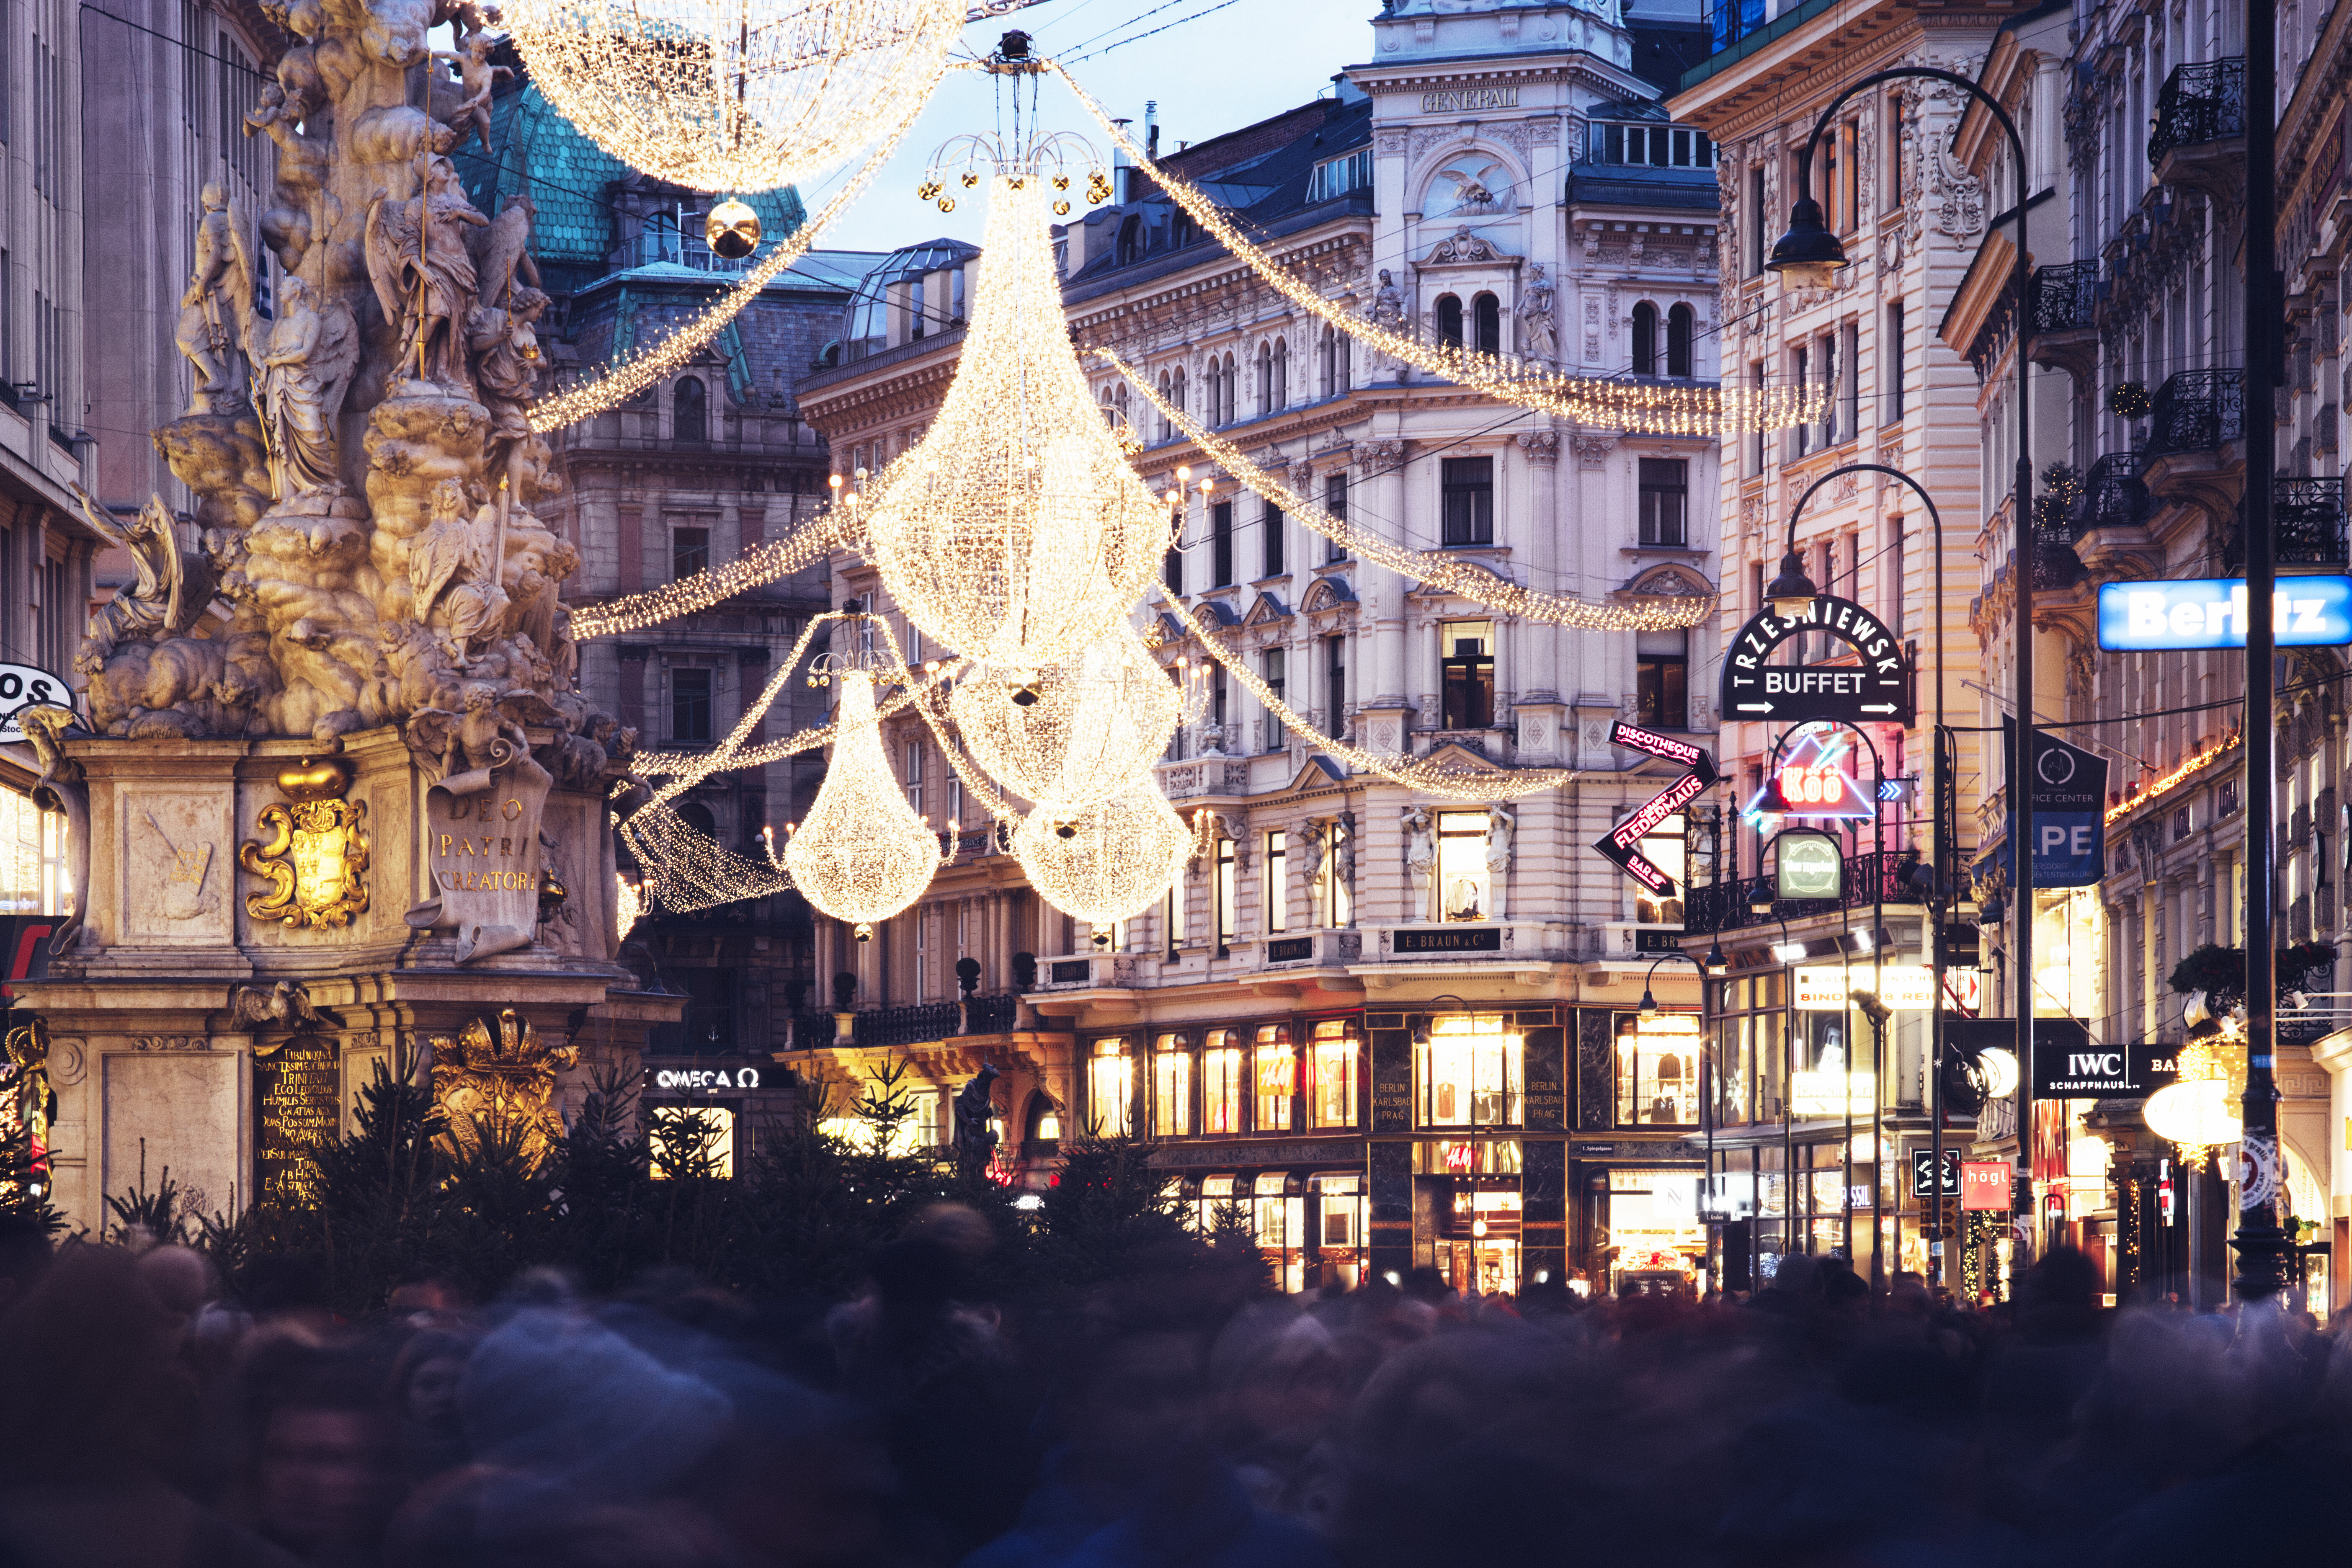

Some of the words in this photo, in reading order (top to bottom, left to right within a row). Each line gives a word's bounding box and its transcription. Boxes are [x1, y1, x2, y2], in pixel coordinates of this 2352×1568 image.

[1420, 85, 1519, 113] GENERALI
[2129, 586, 2326, 636] Berltz
[1766, 673, 1866, 694] BUFFET
[1617, 725, 1700, 759] DISCOTHEQUE
[451, 796, 522, 821] DEO
[1614, 778, 1702, 849] FLEDERMAUS
[1639, 792, 1668, 818] CABARET
[441, 835, 529, 856] PATRI
[1629, 855, 1651, 876] BAR
[438, 870, 536, 891] CREATORI
[1280, 944, 1297, 956] BRAUN
[1406, 936, 1415, 947] E.
[1421, 935, 1459, 947] BRAUN
[1648, 936, 1656, 946] E.
[2068, 1054, 2120, 1075] IWC
[1261, 1064, 1293, 1087] H&M
[1380, 1083, 1405, 1092] BERLIN
[1531, 1082, 1557, 1091] BERLIN
[1373, 1097, 1412, 1106] KARLSBAD
[1524, 1096, 1563, 1104] KARLSBAD
[1382, 1111, 1404, 1120] PRAG
[1534, 1109, 1555, 1118] PRAG
[279, 1127, 296, 1137] PRO
[1447, 1148, 1472, 1167] H&M
